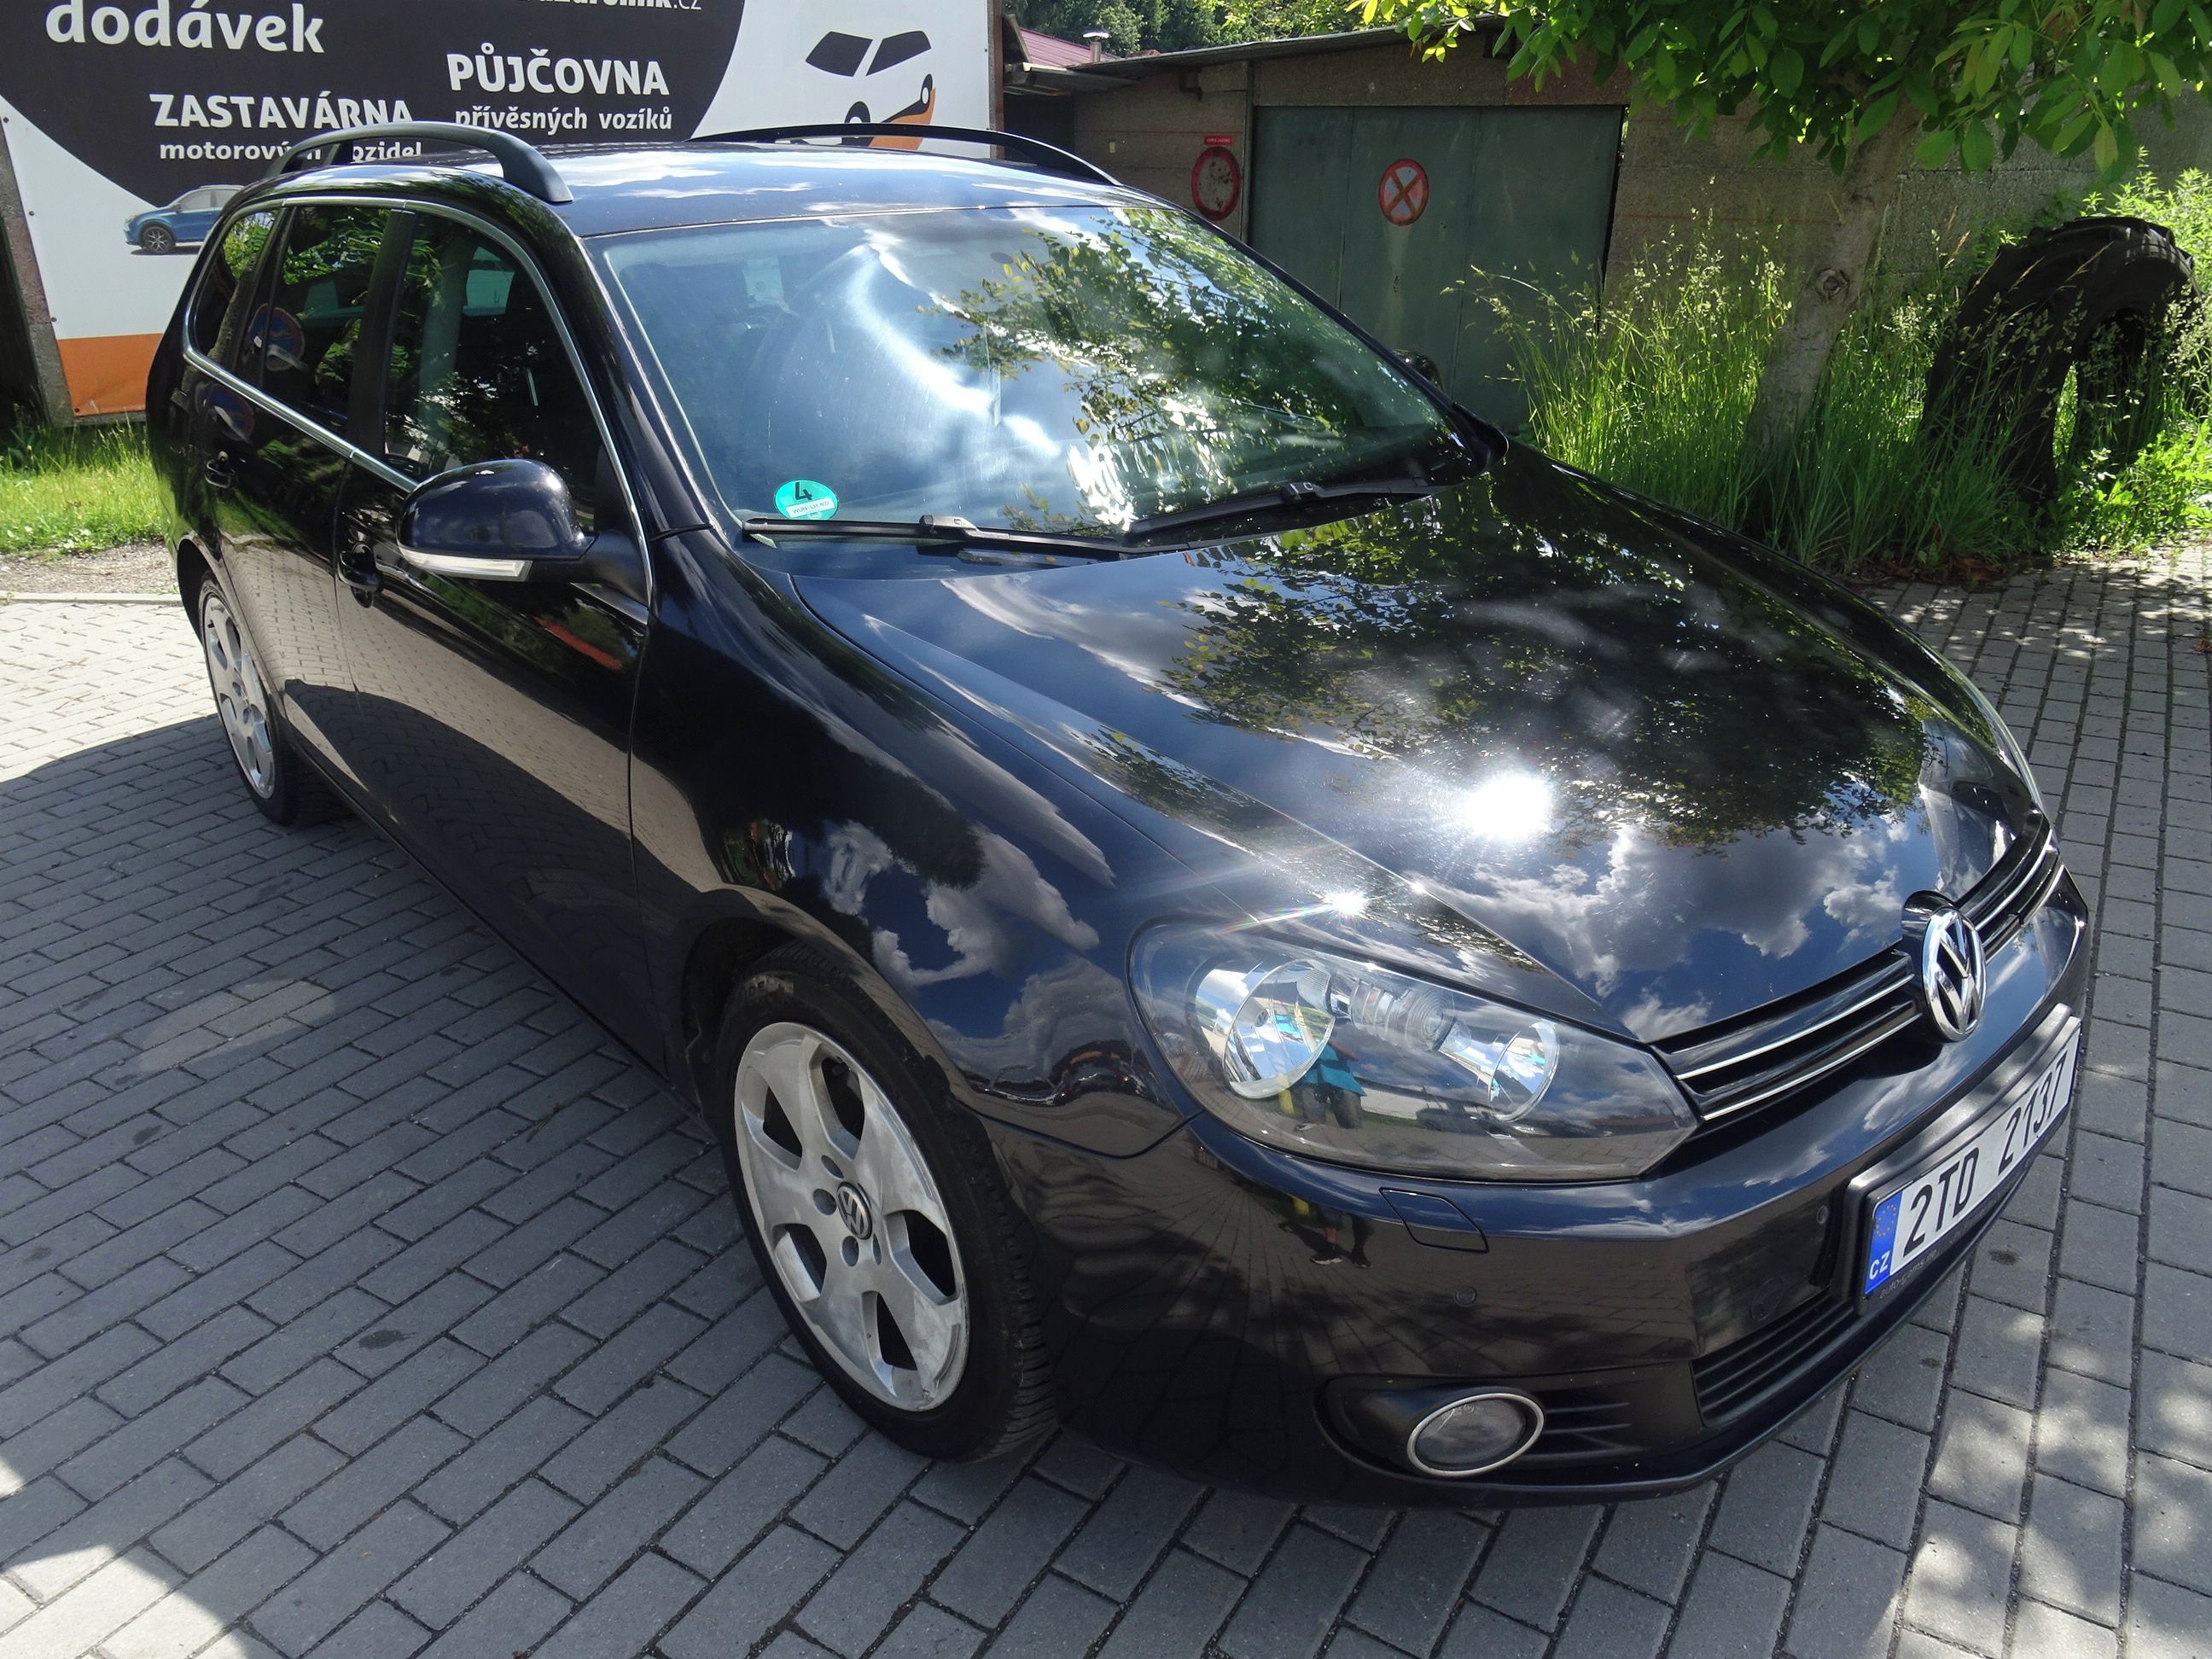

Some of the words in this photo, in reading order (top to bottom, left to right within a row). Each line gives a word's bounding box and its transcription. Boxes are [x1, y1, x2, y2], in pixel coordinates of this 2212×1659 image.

[45, 0, 325, 53] dodávek
[446, 42, 670, 96] PŮJČOVNA
[149, 90, 414, 130] ZASTAVÁRNA
[455, 105, 588, 136] přívěsných
[598, 106, 672, 130] vozíků
[160, 141, 322, 160] motorový
[348, 141, 422, 161] ozidel
[795, 481, 812, 500] 4
[1903, 1147, 1980, 1258] 2TD
[1998, 1050, 2068, 1176] 2137
[1869, 1250, 1891, 1280] CZ
